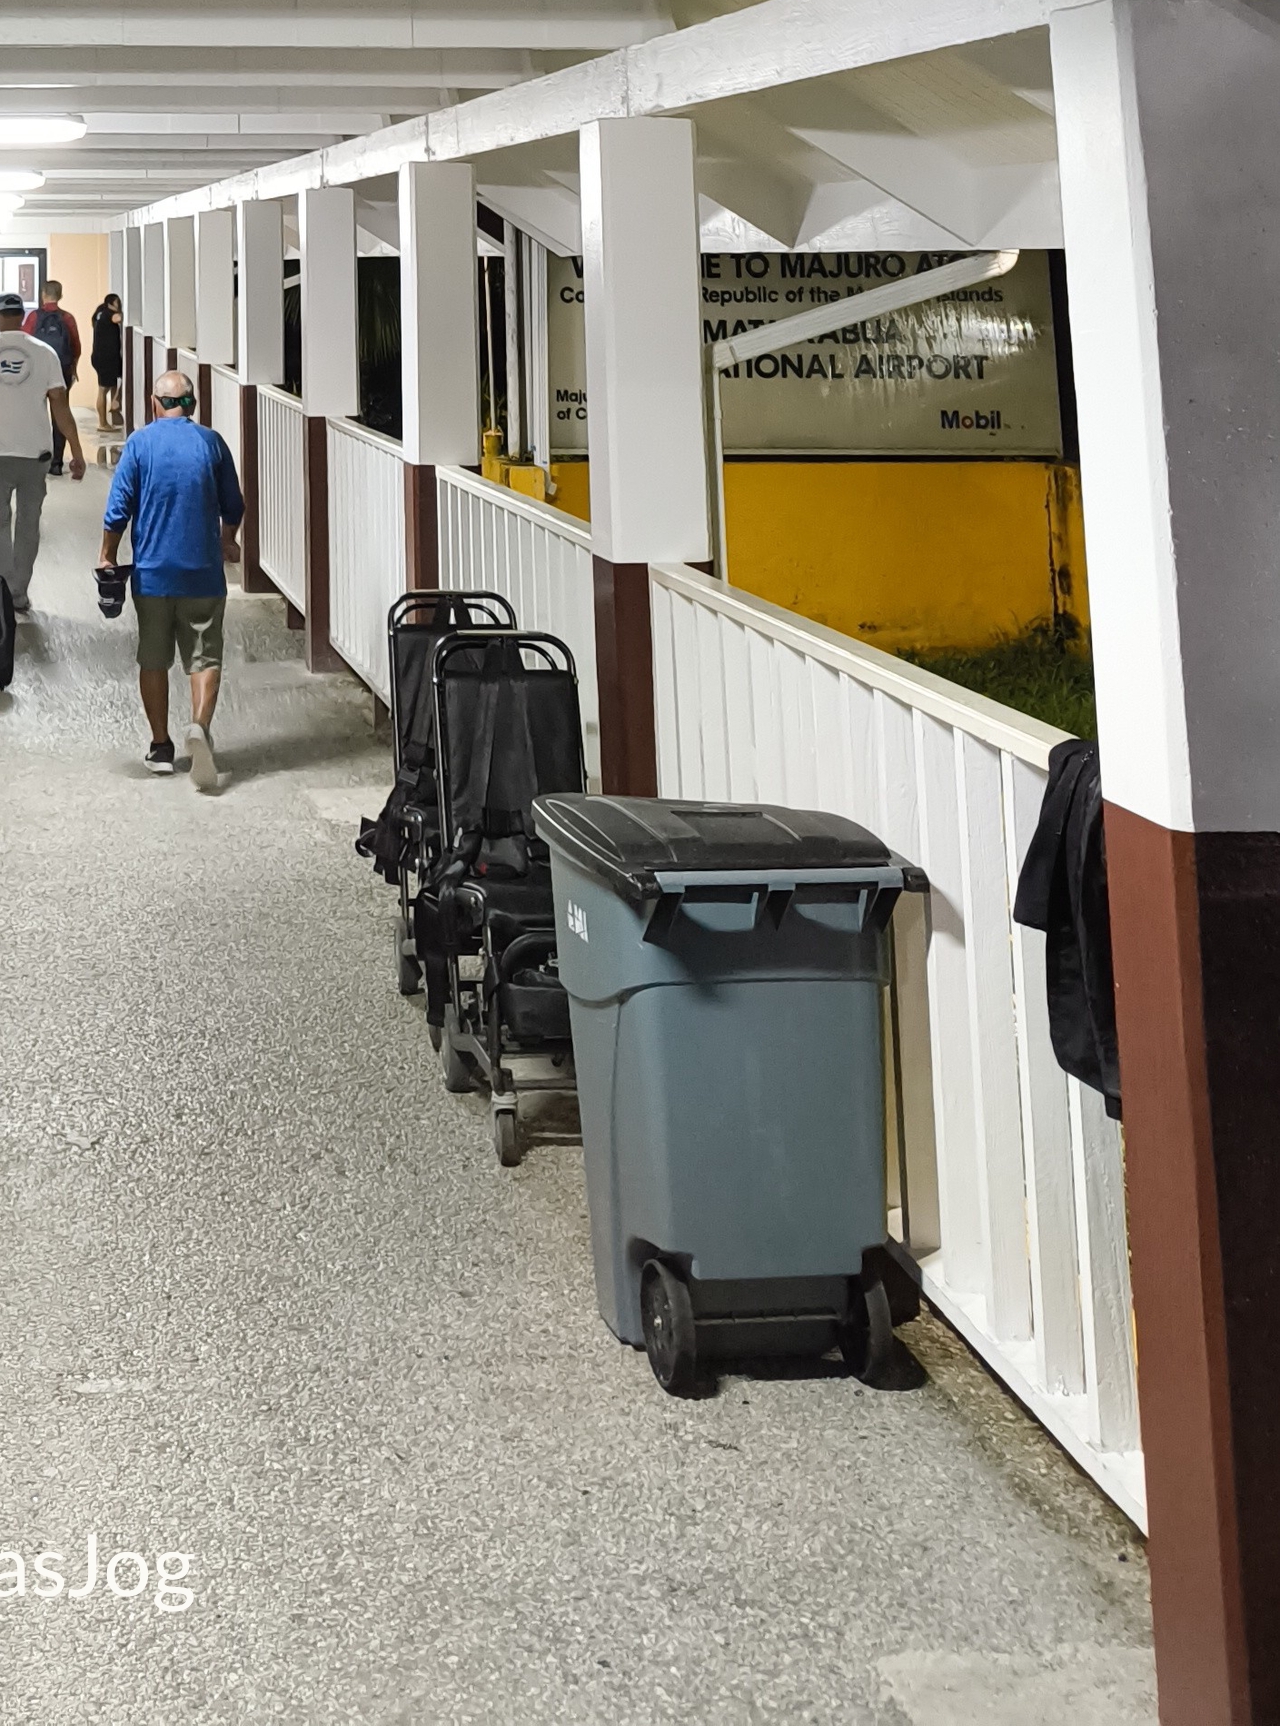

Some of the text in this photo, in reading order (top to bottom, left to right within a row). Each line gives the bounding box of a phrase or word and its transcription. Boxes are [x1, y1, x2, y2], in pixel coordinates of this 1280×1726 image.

[730, 254, 770, 278] TO
[780, 253, 906, 279] MAJURO
[785, 287, 805, 303] of
[810, 287, 841, 303] the
[853, 353, 989, 380] AIRPORT
[940, 409, 1001, 430] Mobil
